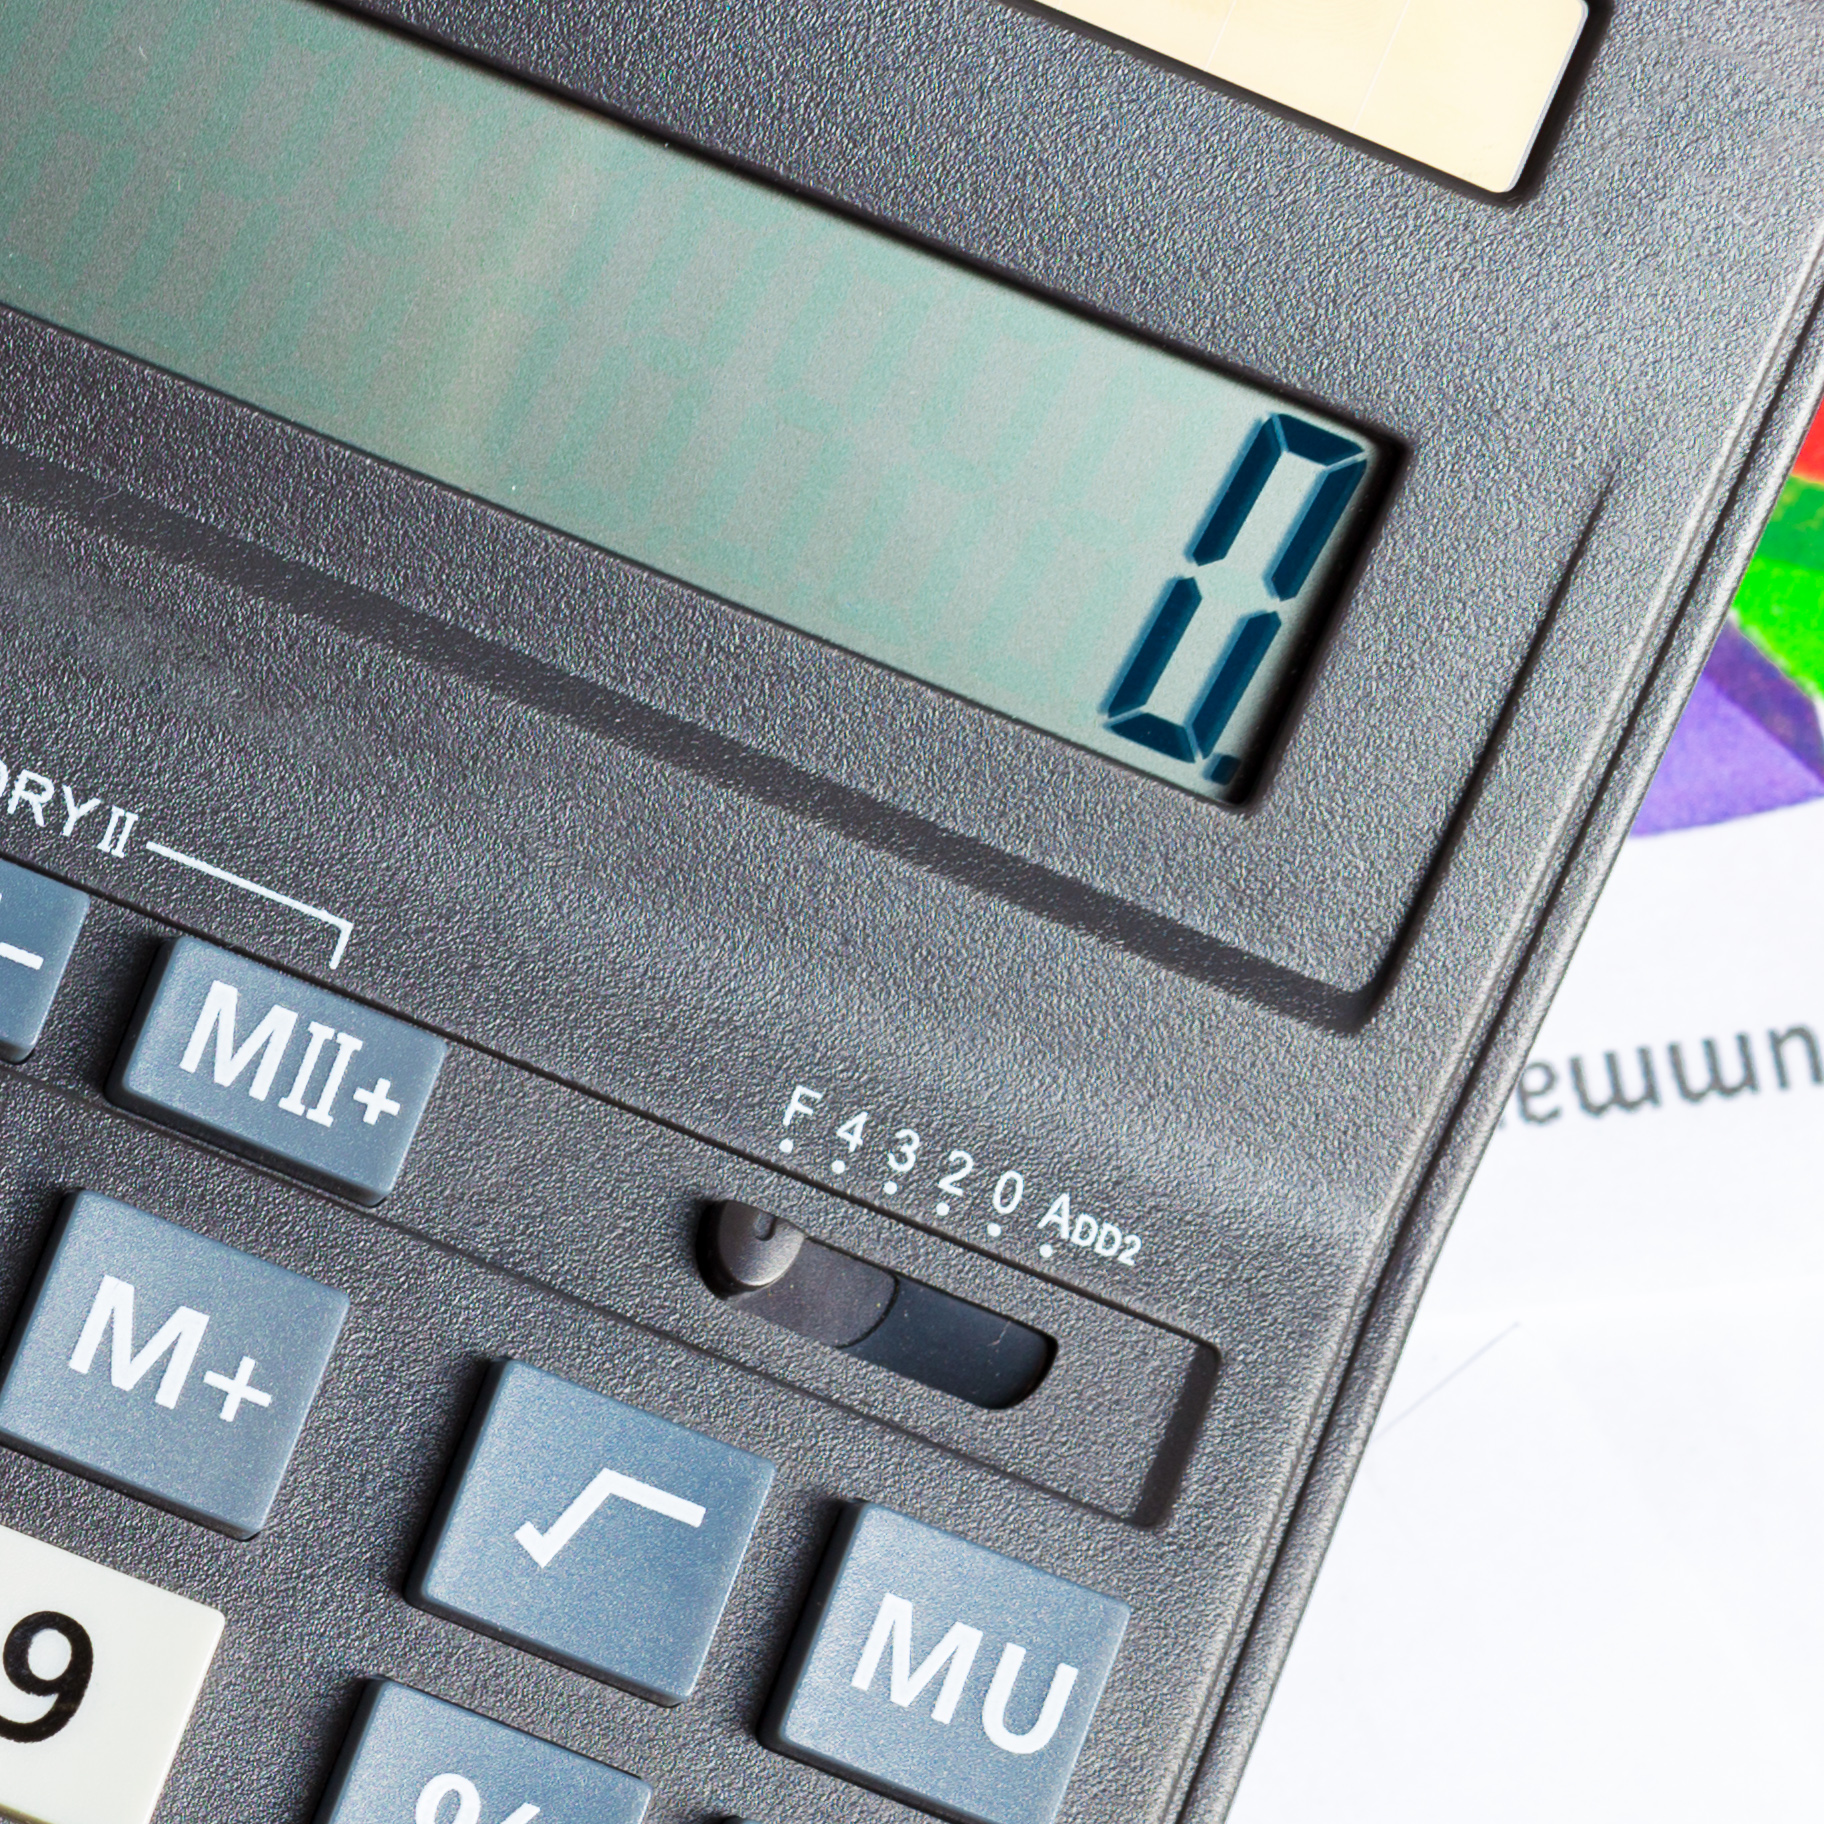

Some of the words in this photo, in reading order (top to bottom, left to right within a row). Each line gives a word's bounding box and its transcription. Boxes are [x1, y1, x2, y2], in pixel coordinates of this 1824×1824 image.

[1494, 1026, 1824, 1127] umma
[783, 1085, 823, 1125] F
[837, 1112, 868, 1152] 4
[888, 1129, 921, 1173] 3
[938, 1150, 975, 1196] 2
[993, 1171, 1024, 1214] 0
[69, 1274, 271, 1421] M+
[851, 1592, 1078, 1754] MU
